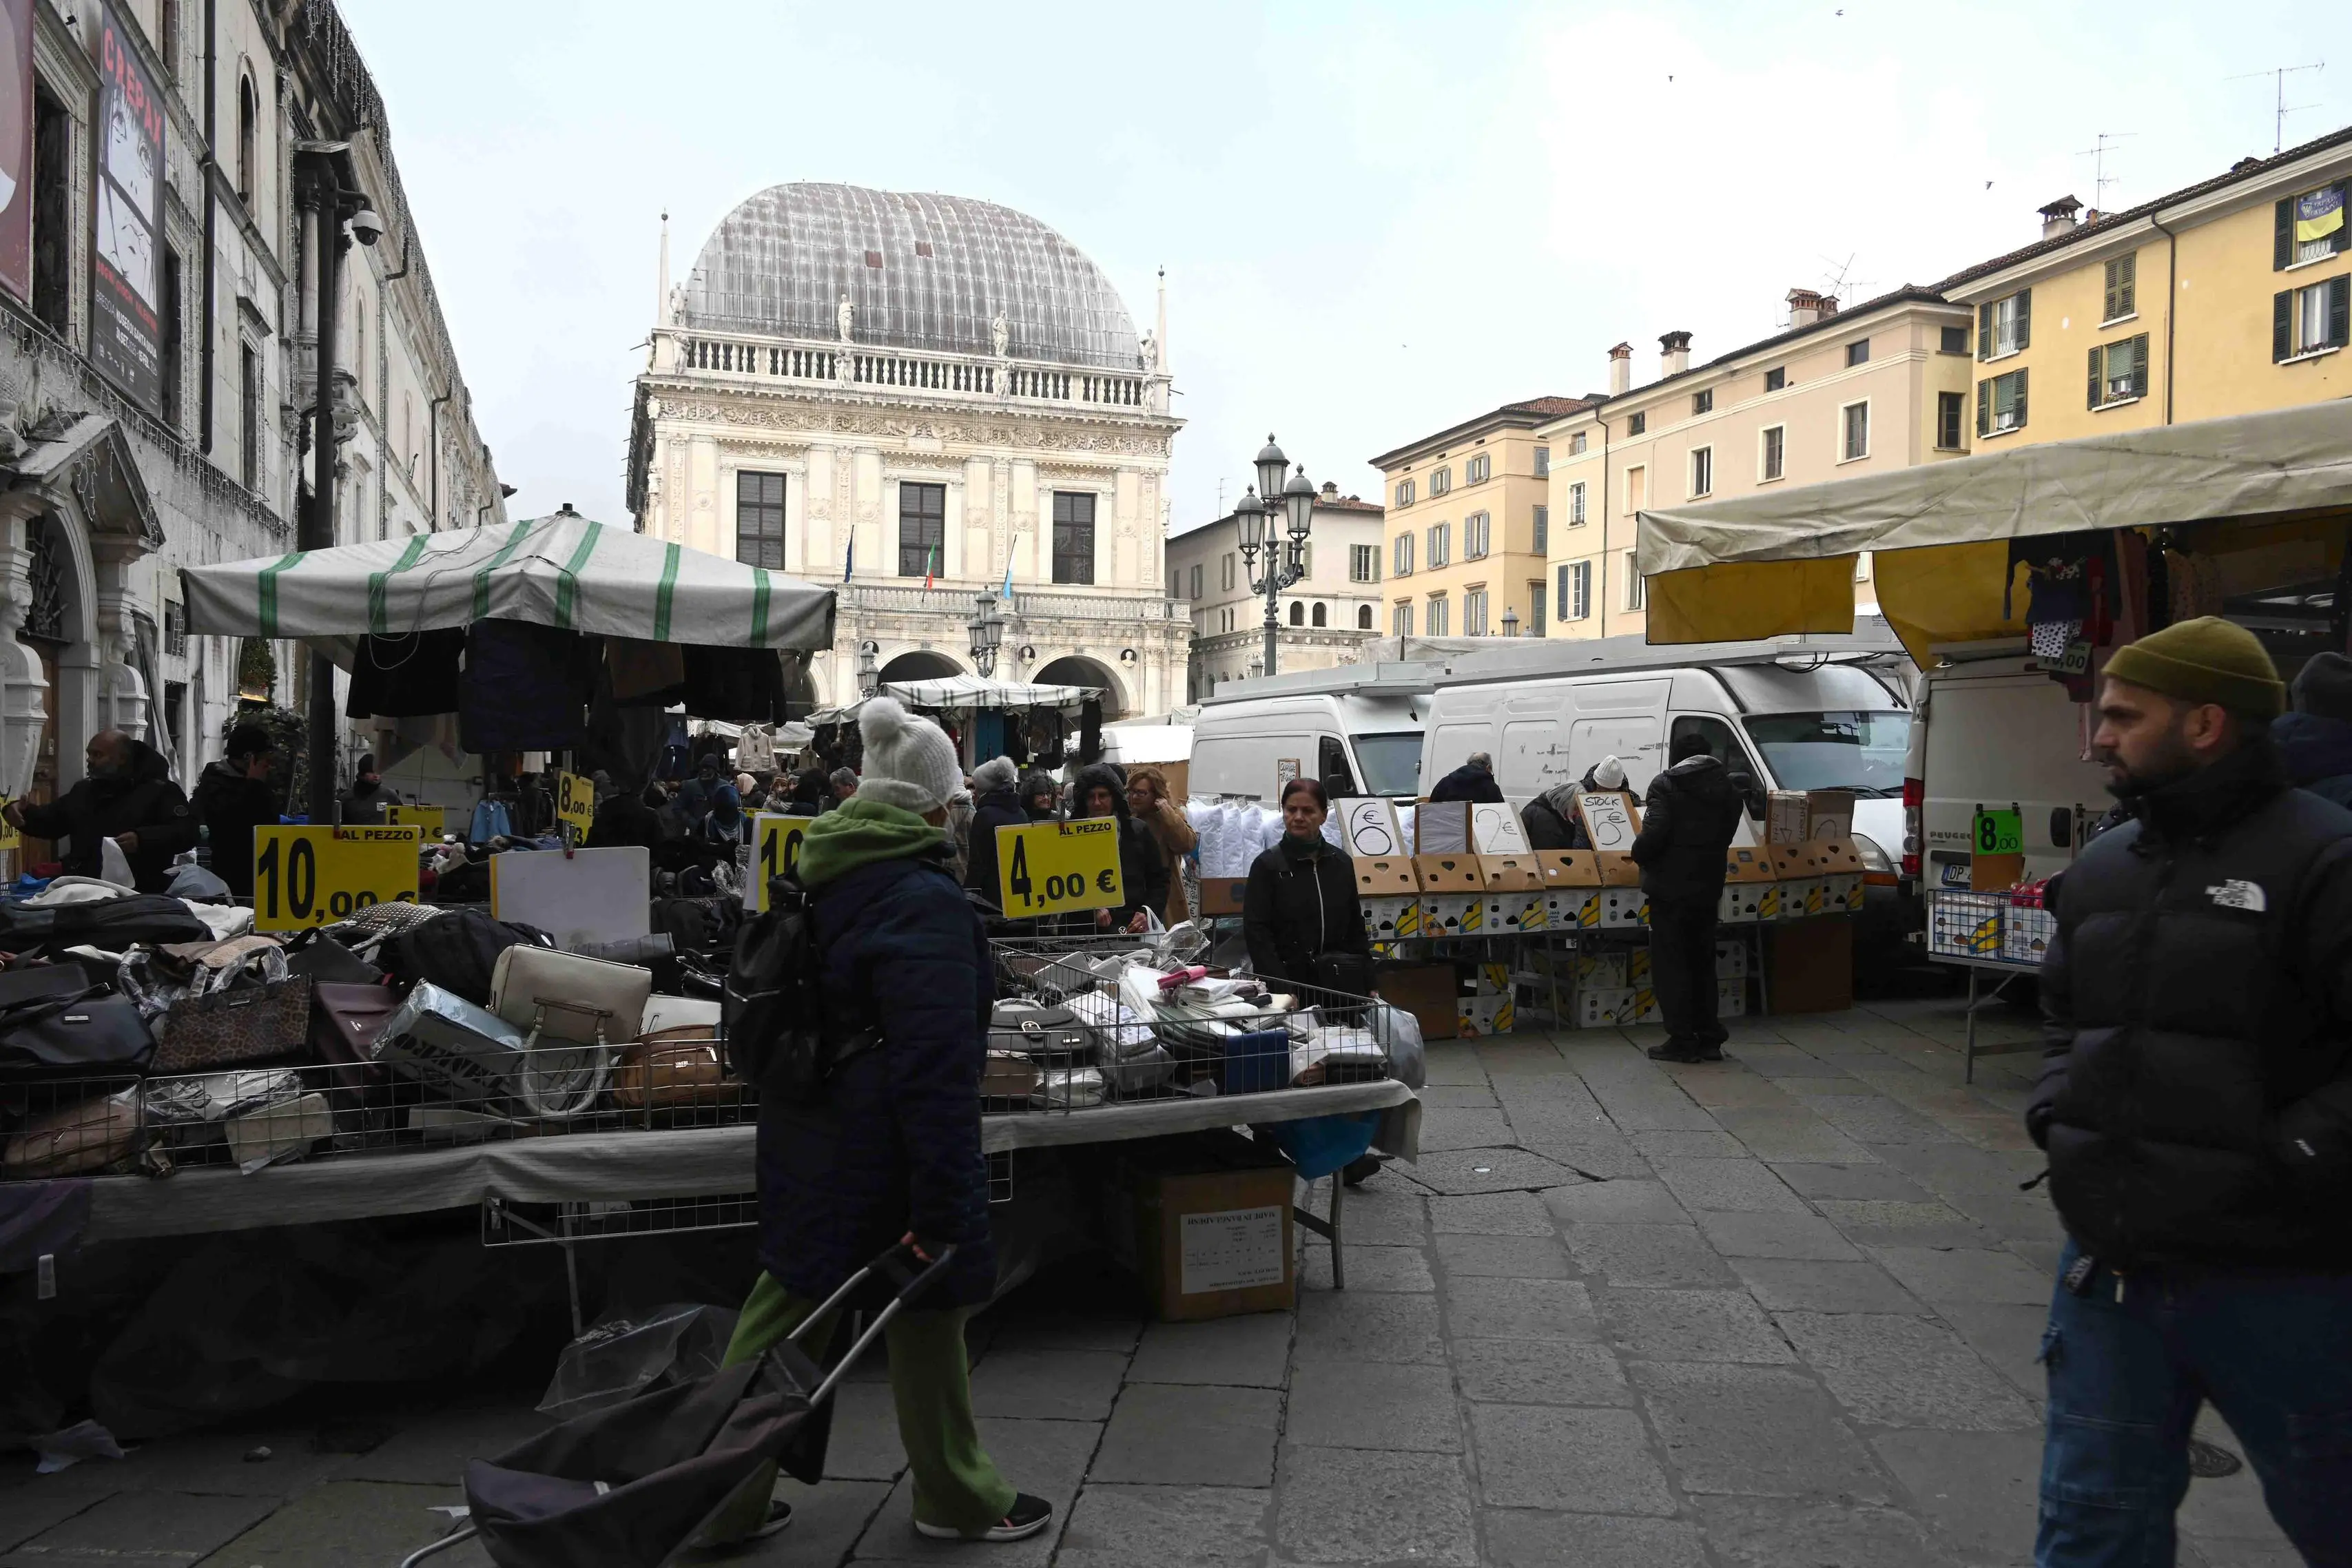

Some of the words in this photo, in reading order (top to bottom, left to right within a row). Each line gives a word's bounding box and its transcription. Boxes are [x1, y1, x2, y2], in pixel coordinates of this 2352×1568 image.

[104, 28, 162, 151] CREPAX
[560, 776, 585, 814] 8,00
[1584, 796, 1620, 806] STOCK
[339, 830, 360, 840] AL
[364, 830, 414, 840] PEZZO
[1060, 826, 1073, 836] AL
[1076, 822, 1112, 834] PEZZO
[1980, 816, 2019, 852] 8,00
[1010, 834, 1085, 908] 4,00
[1096, 869, 1117, 894] €
[1949, 865, 1963, 880] DP
